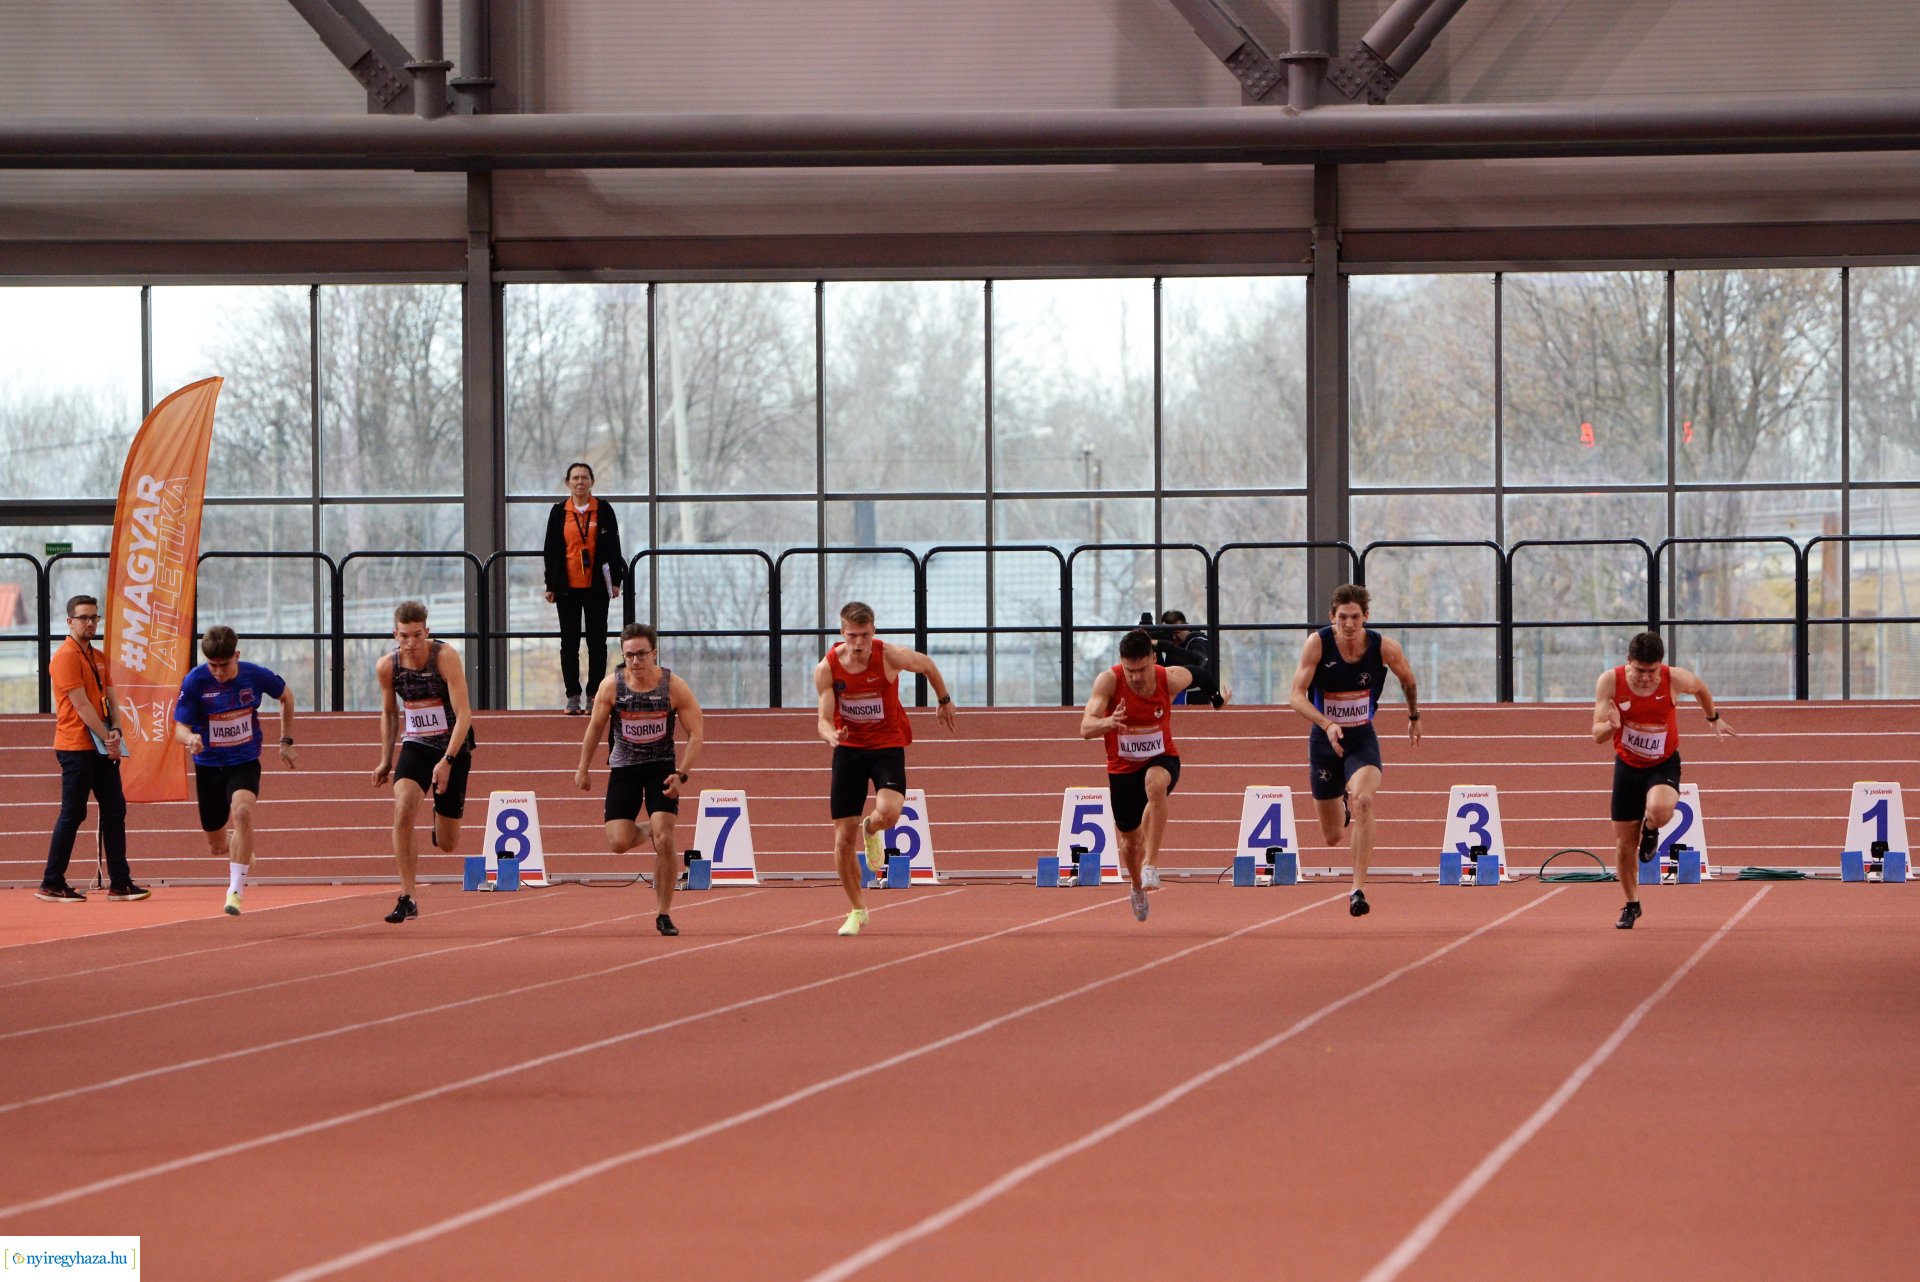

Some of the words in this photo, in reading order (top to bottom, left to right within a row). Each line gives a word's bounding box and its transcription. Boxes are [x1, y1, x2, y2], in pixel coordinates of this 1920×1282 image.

[120, 474, 165, 672] #MAGYAR
[149, 477, 191, 671] ATLETIKA
[152, 701, 165, 742] MASZ
[212, 725, 241, 738] VARGA
[410, 713, 439, 728] BOLLA
[625, 722, 664, 737] CSORNAI
[494, 808, 531, 863] 8
[704, 807, 741, 862] 7
[884, 806, 921, 861] 6
[1069, 804, 1106, 854] 5
[1247, 803, 1288, 848] 4
[1456, 802, 1492, 859] 3
[1658, 801, 1694, 857] 2
[1862, 799, 1888, 842] 1
